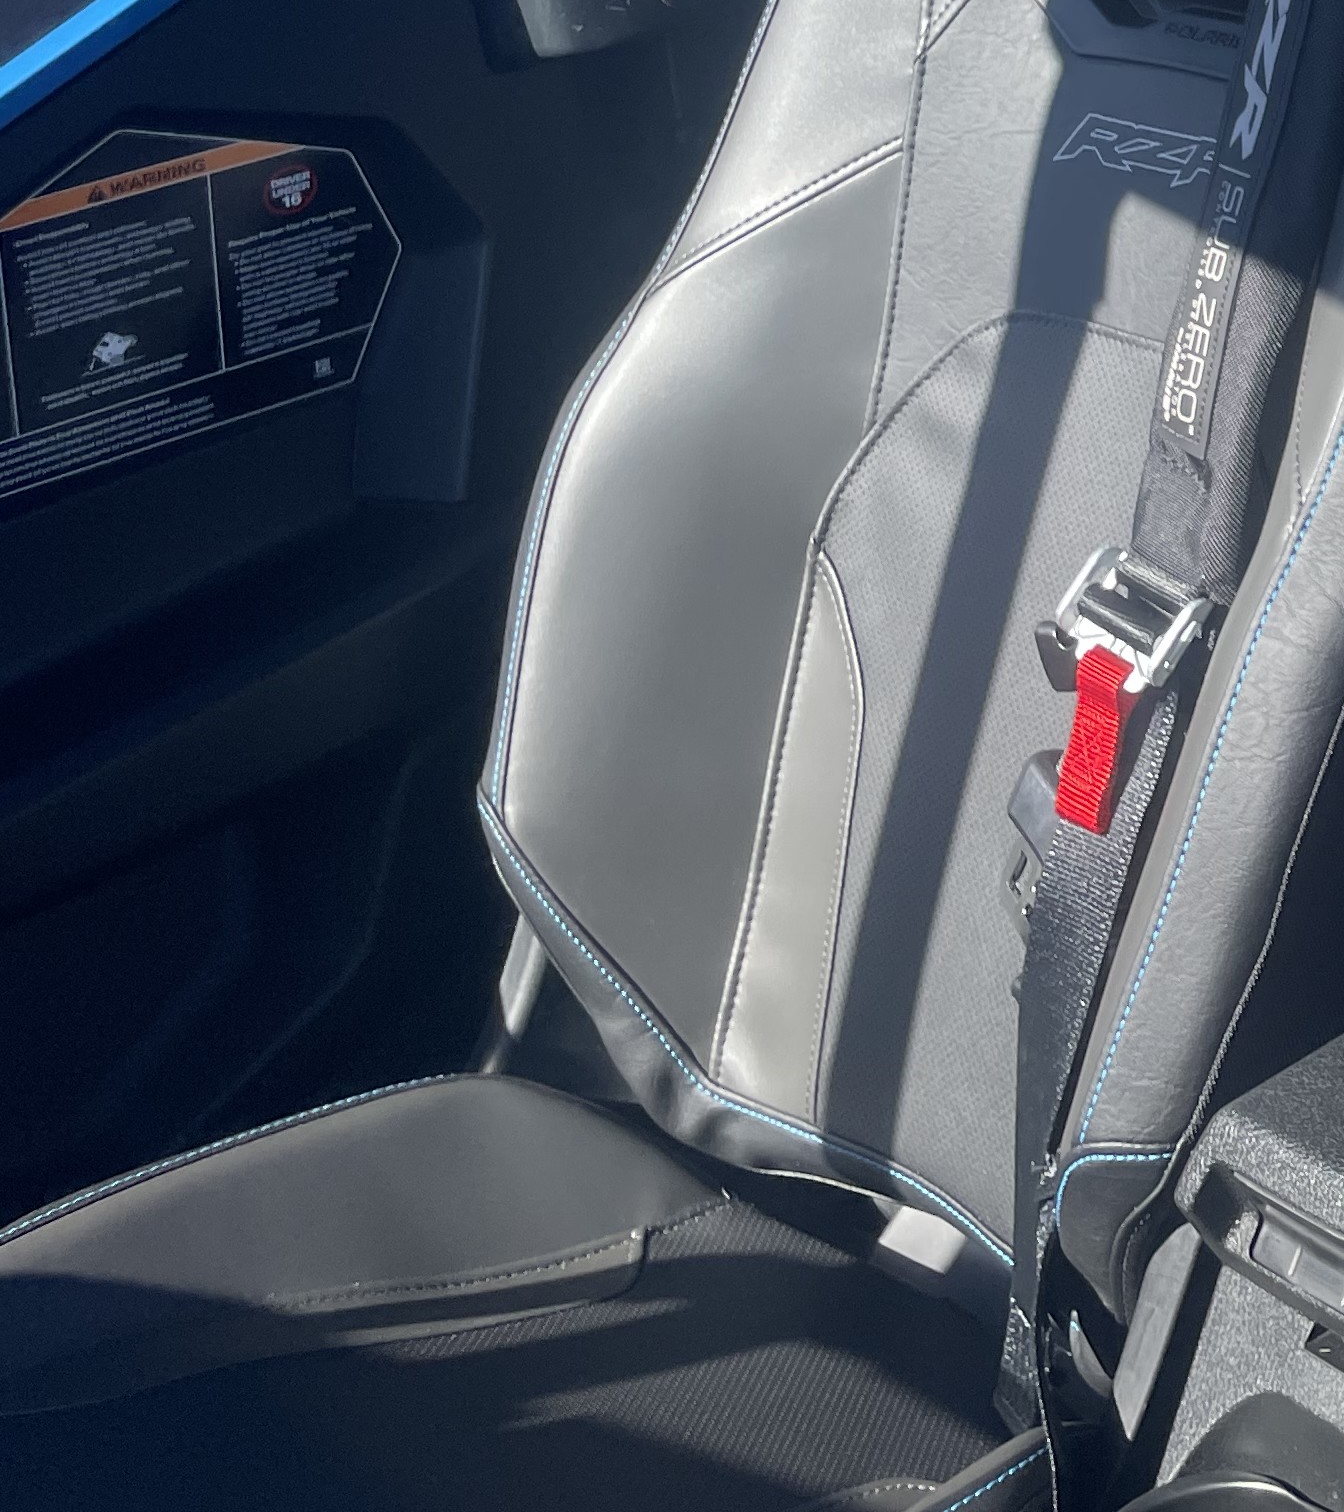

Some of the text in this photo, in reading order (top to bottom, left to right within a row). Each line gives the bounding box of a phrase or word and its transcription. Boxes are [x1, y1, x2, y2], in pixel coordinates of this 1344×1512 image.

[110, 158, 206, 196] WARNING
[271, 171, 310, 189] DRIVER
[1176, 184, 1245, 424] SUB ZERO
